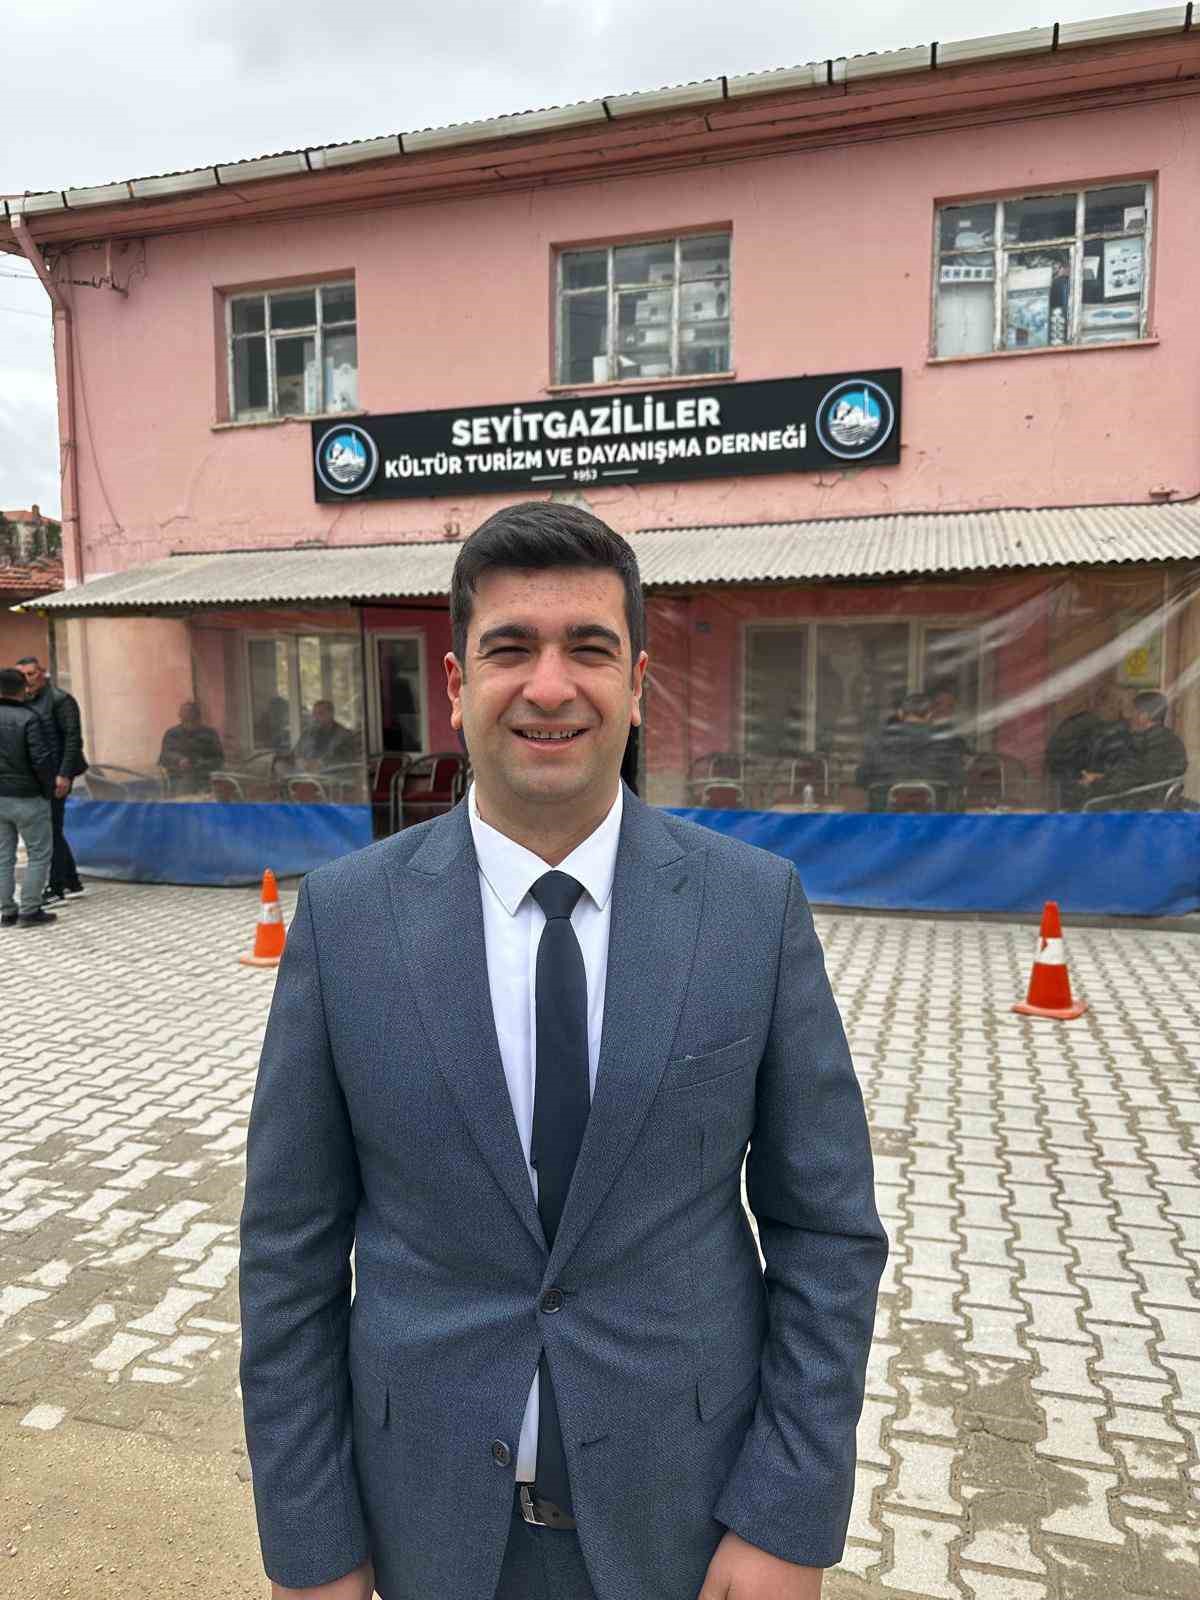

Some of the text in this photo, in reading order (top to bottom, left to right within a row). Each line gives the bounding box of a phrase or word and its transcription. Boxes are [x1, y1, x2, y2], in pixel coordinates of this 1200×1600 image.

[451, 395, 721, 447] SEYİTGAZİLİLER
[385, 423, 807, 479] KÜLTÜR TURİZM VE DAYANIŞMA DERNEĞİ
